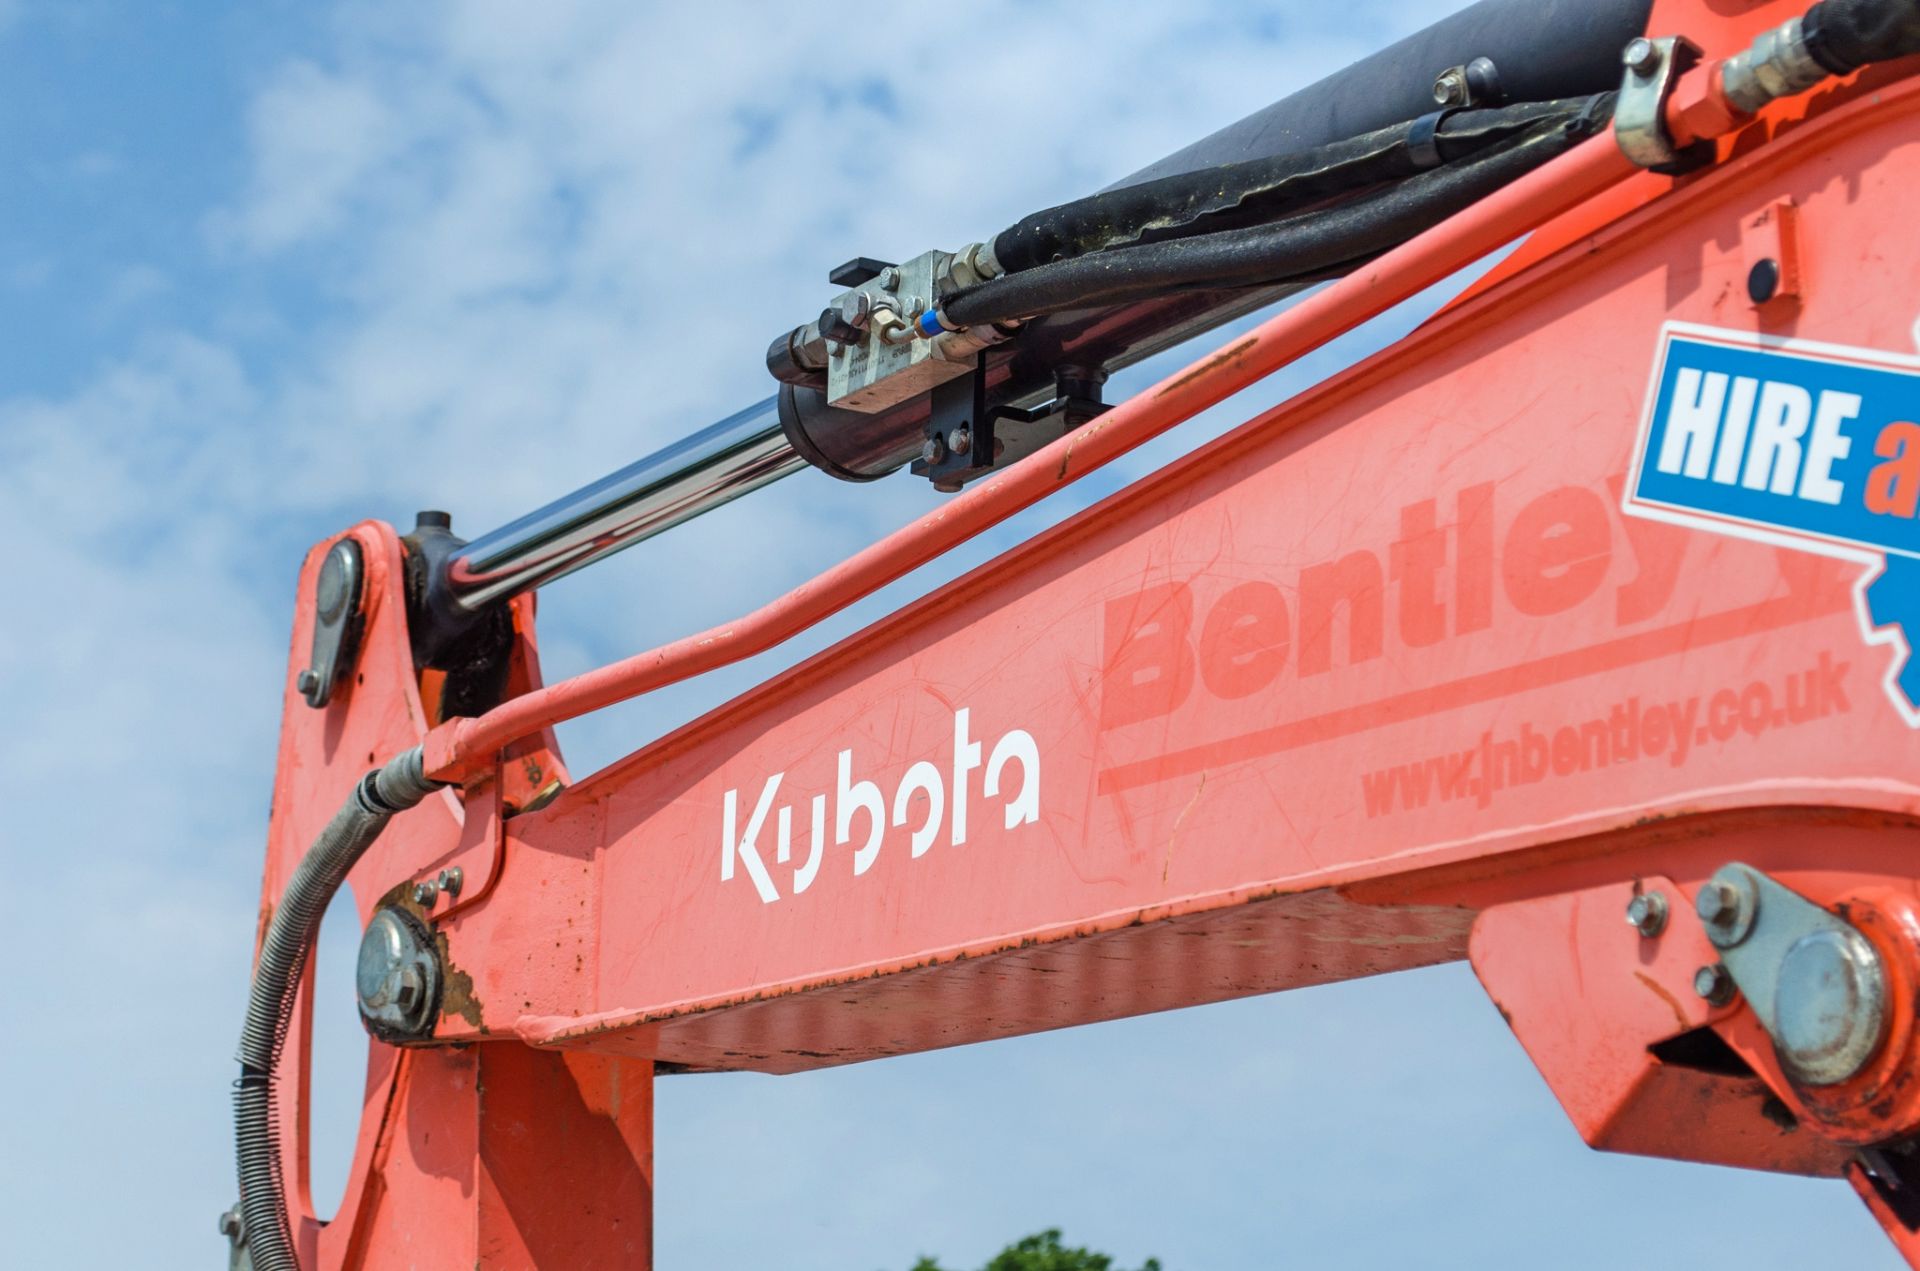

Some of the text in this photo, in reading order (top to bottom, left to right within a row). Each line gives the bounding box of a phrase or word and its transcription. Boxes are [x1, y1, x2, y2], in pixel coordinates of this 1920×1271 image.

[1656, 366, 1920, 519] HIRE a
[1101, 474, 1692, 732] Bentley
[721, 707, 1040, 904] Kubota
[1361, 649, 1852, 819] www.jnbentley.co.uk
